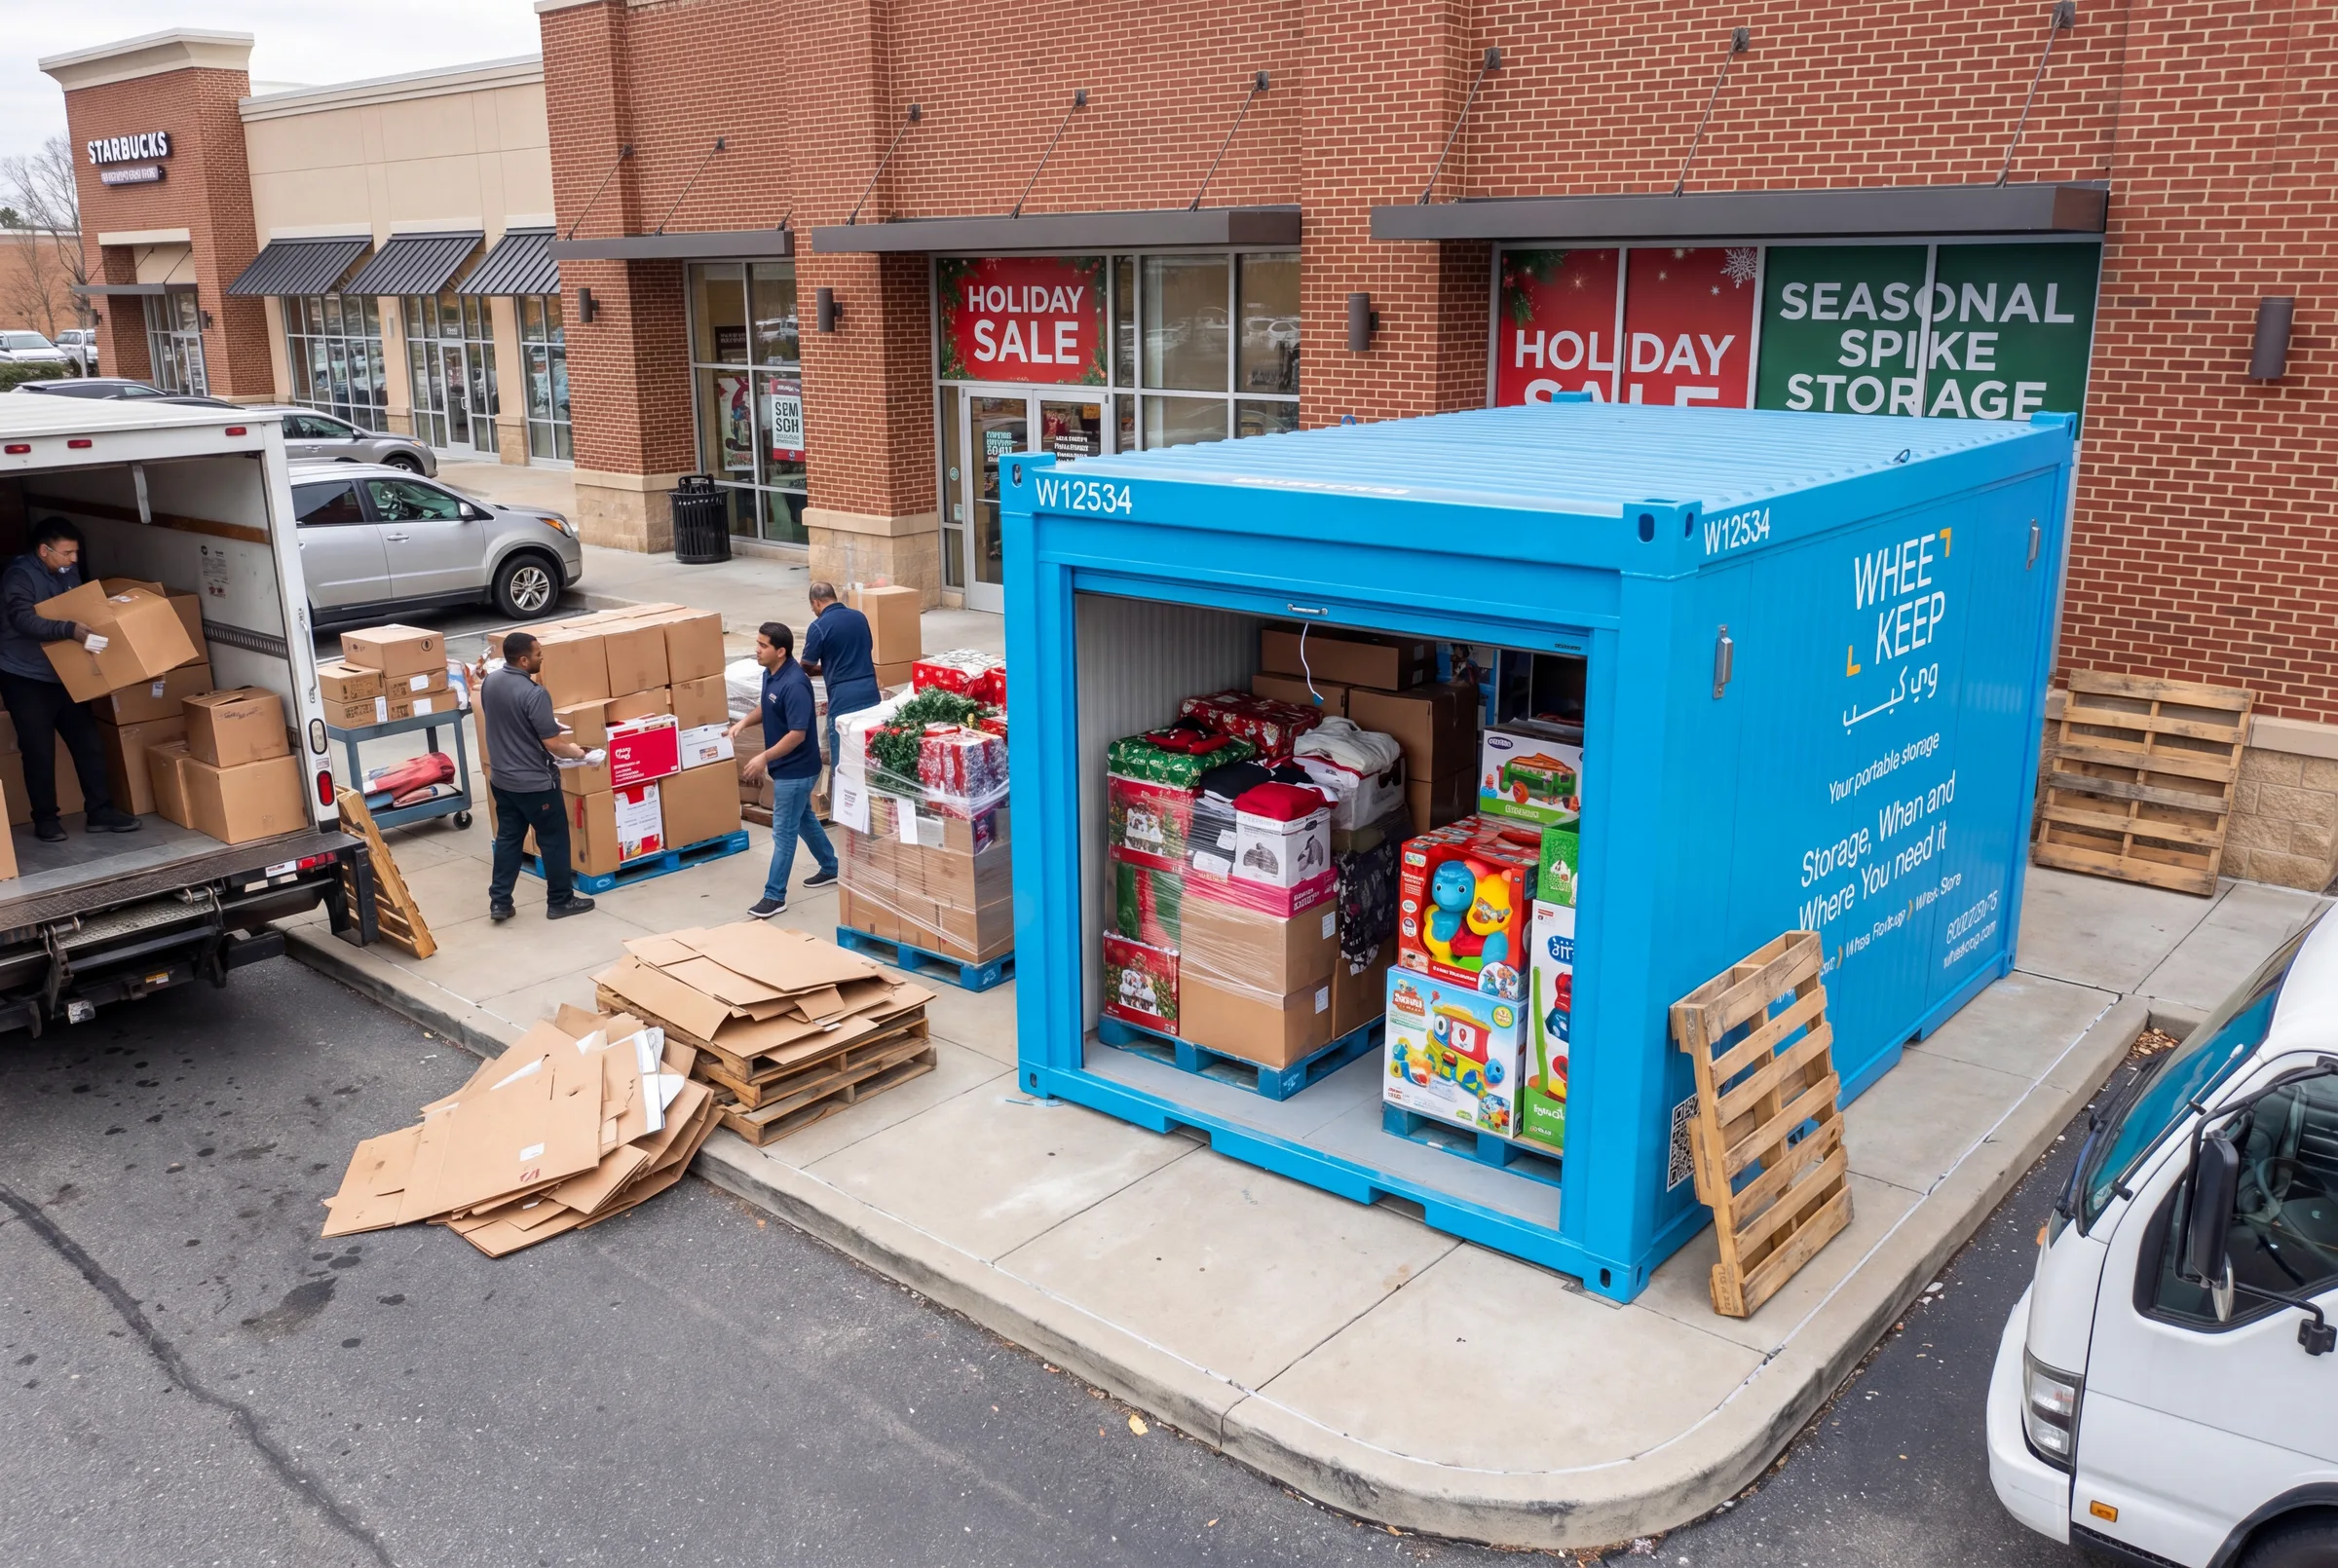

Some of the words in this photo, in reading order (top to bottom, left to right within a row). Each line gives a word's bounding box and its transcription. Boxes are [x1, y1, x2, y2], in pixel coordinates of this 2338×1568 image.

[88, 131, 168, 165] STARBUCKS
[967, 285, 1084, 314] HOLIDAY
[1779, 281, 2075, 323] SEASONAL
[974, 319, 1080, 364] SALE
[1515, 329, 1736, 376] HOLDAY
[1837, 328, 1999, 371] SPIKE
[1785, 373, 2047, 421] STORAGE
[1035, 477, 1133, 515] W12534
[1704, 506, 1770, 556] W12534
[1854, 533, 1936, 611] WHEE
[1875, 590, 1945, 665] KEEP
[1829, 776, 1855, 804] Your
[1854, 749, 1901, 796] portable
[1801, 827, 1872, 888] Storage,
[1926, 769, 1956, 814] and
[1798, 883, 1855, 931] Where
[1861, 860, 1891, 900] You
[1894, 825, 1935, 879] need
[1937, 819, 1947, 852] it
